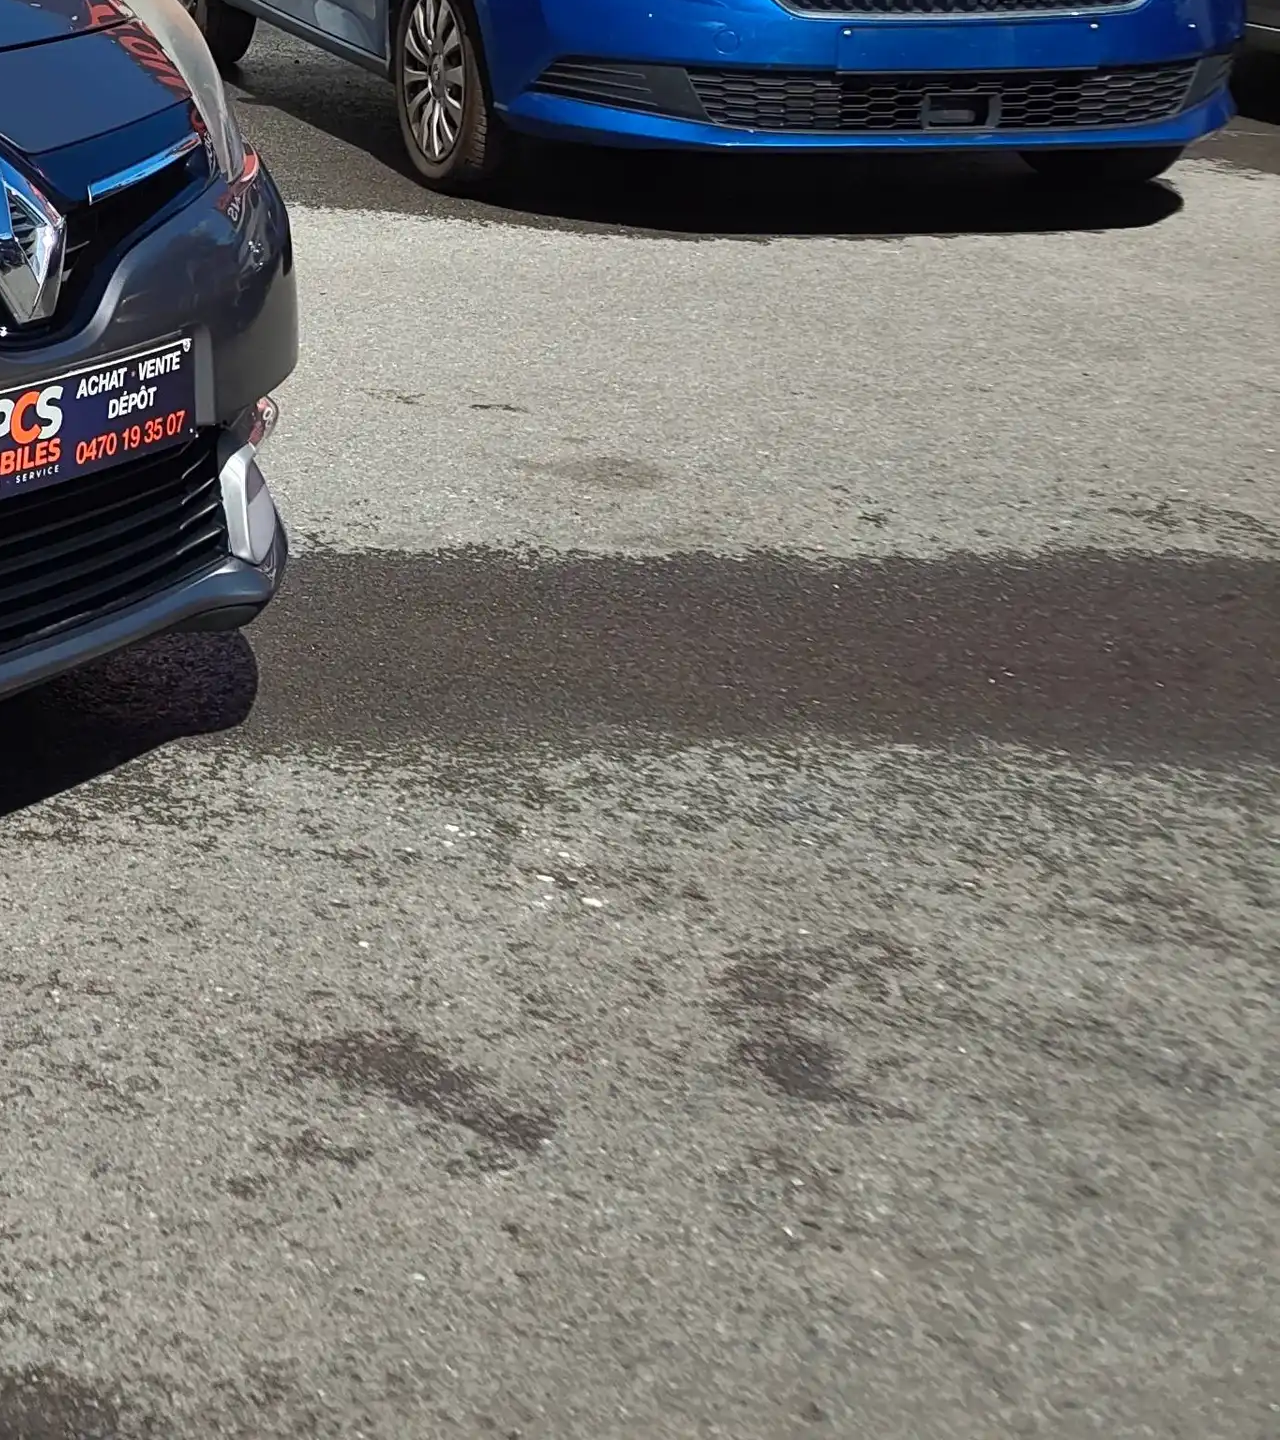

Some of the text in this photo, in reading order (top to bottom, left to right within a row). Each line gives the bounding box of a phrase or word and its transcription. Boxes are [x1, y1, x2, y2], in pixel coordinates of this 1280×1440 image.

[76, 351, 181, 400] ACHAT VENTE
[108, 387, 157, 419] DÉPÔT
[75, 410, 186, 465] 0470 19 35 07
[15, 464, 61, 484] SERVICE
